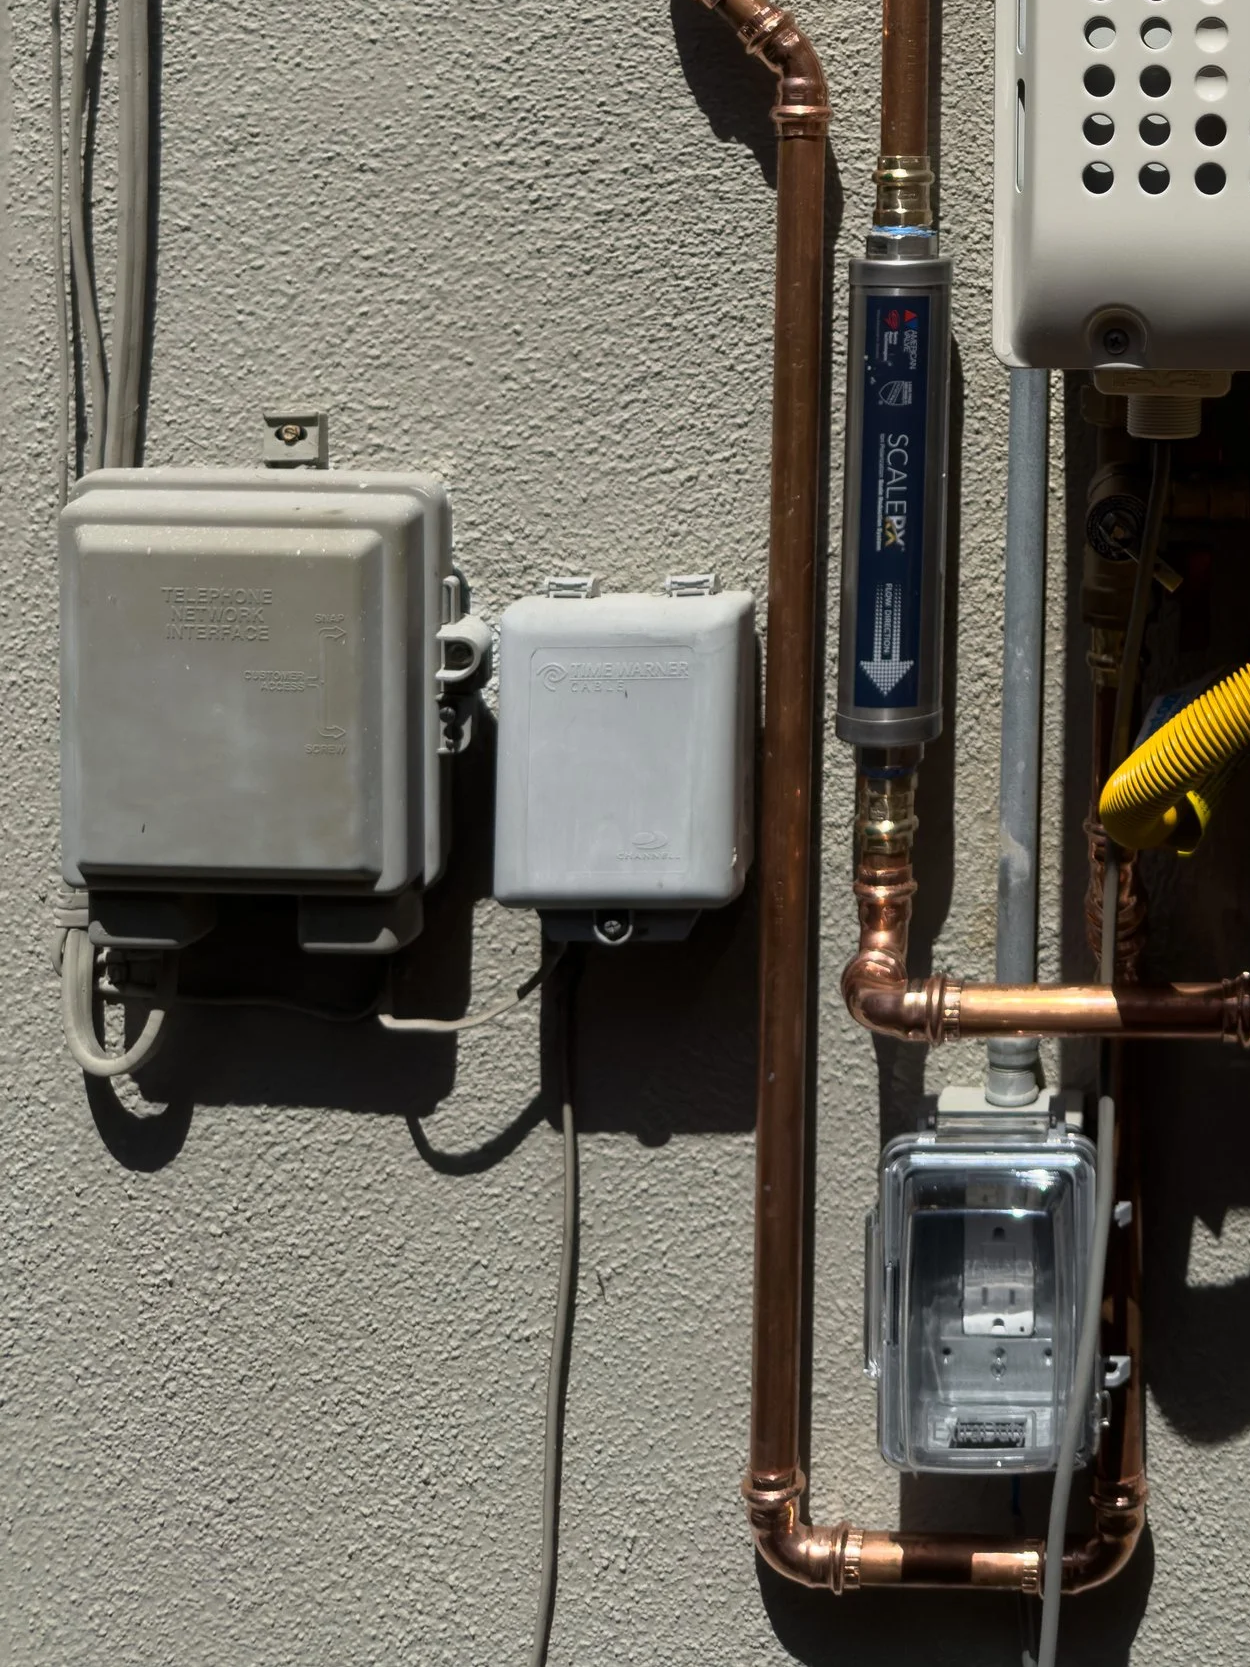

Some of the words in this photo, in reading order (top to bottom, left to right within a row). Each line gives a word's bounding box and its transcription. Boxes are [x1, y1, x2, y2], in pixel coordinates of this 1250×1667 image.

[903, 330, 911, 352] VALVE
[909, 330, 918, 370] AMERICAN
[161, 587, 273, 605] TELEPHONE
[884, 583, 894, 605] FLOW
[170, 606, 264, 624] NETWORK
[314, 614, 345, 624] SNAP
[165, 624, 270, 641] INTERFACE
[882, 610, 893, 653] DIRECTION
[243, 670, 305, 681] CUSTOMER
[570, 662, 612, 678] TIME
[617, 662, 689, 677] WARNER
[260, 681, 306, 691] ACCESS
[570, 681, 625, 693] CABLE
[304, 744, 346, 756] SCREW
